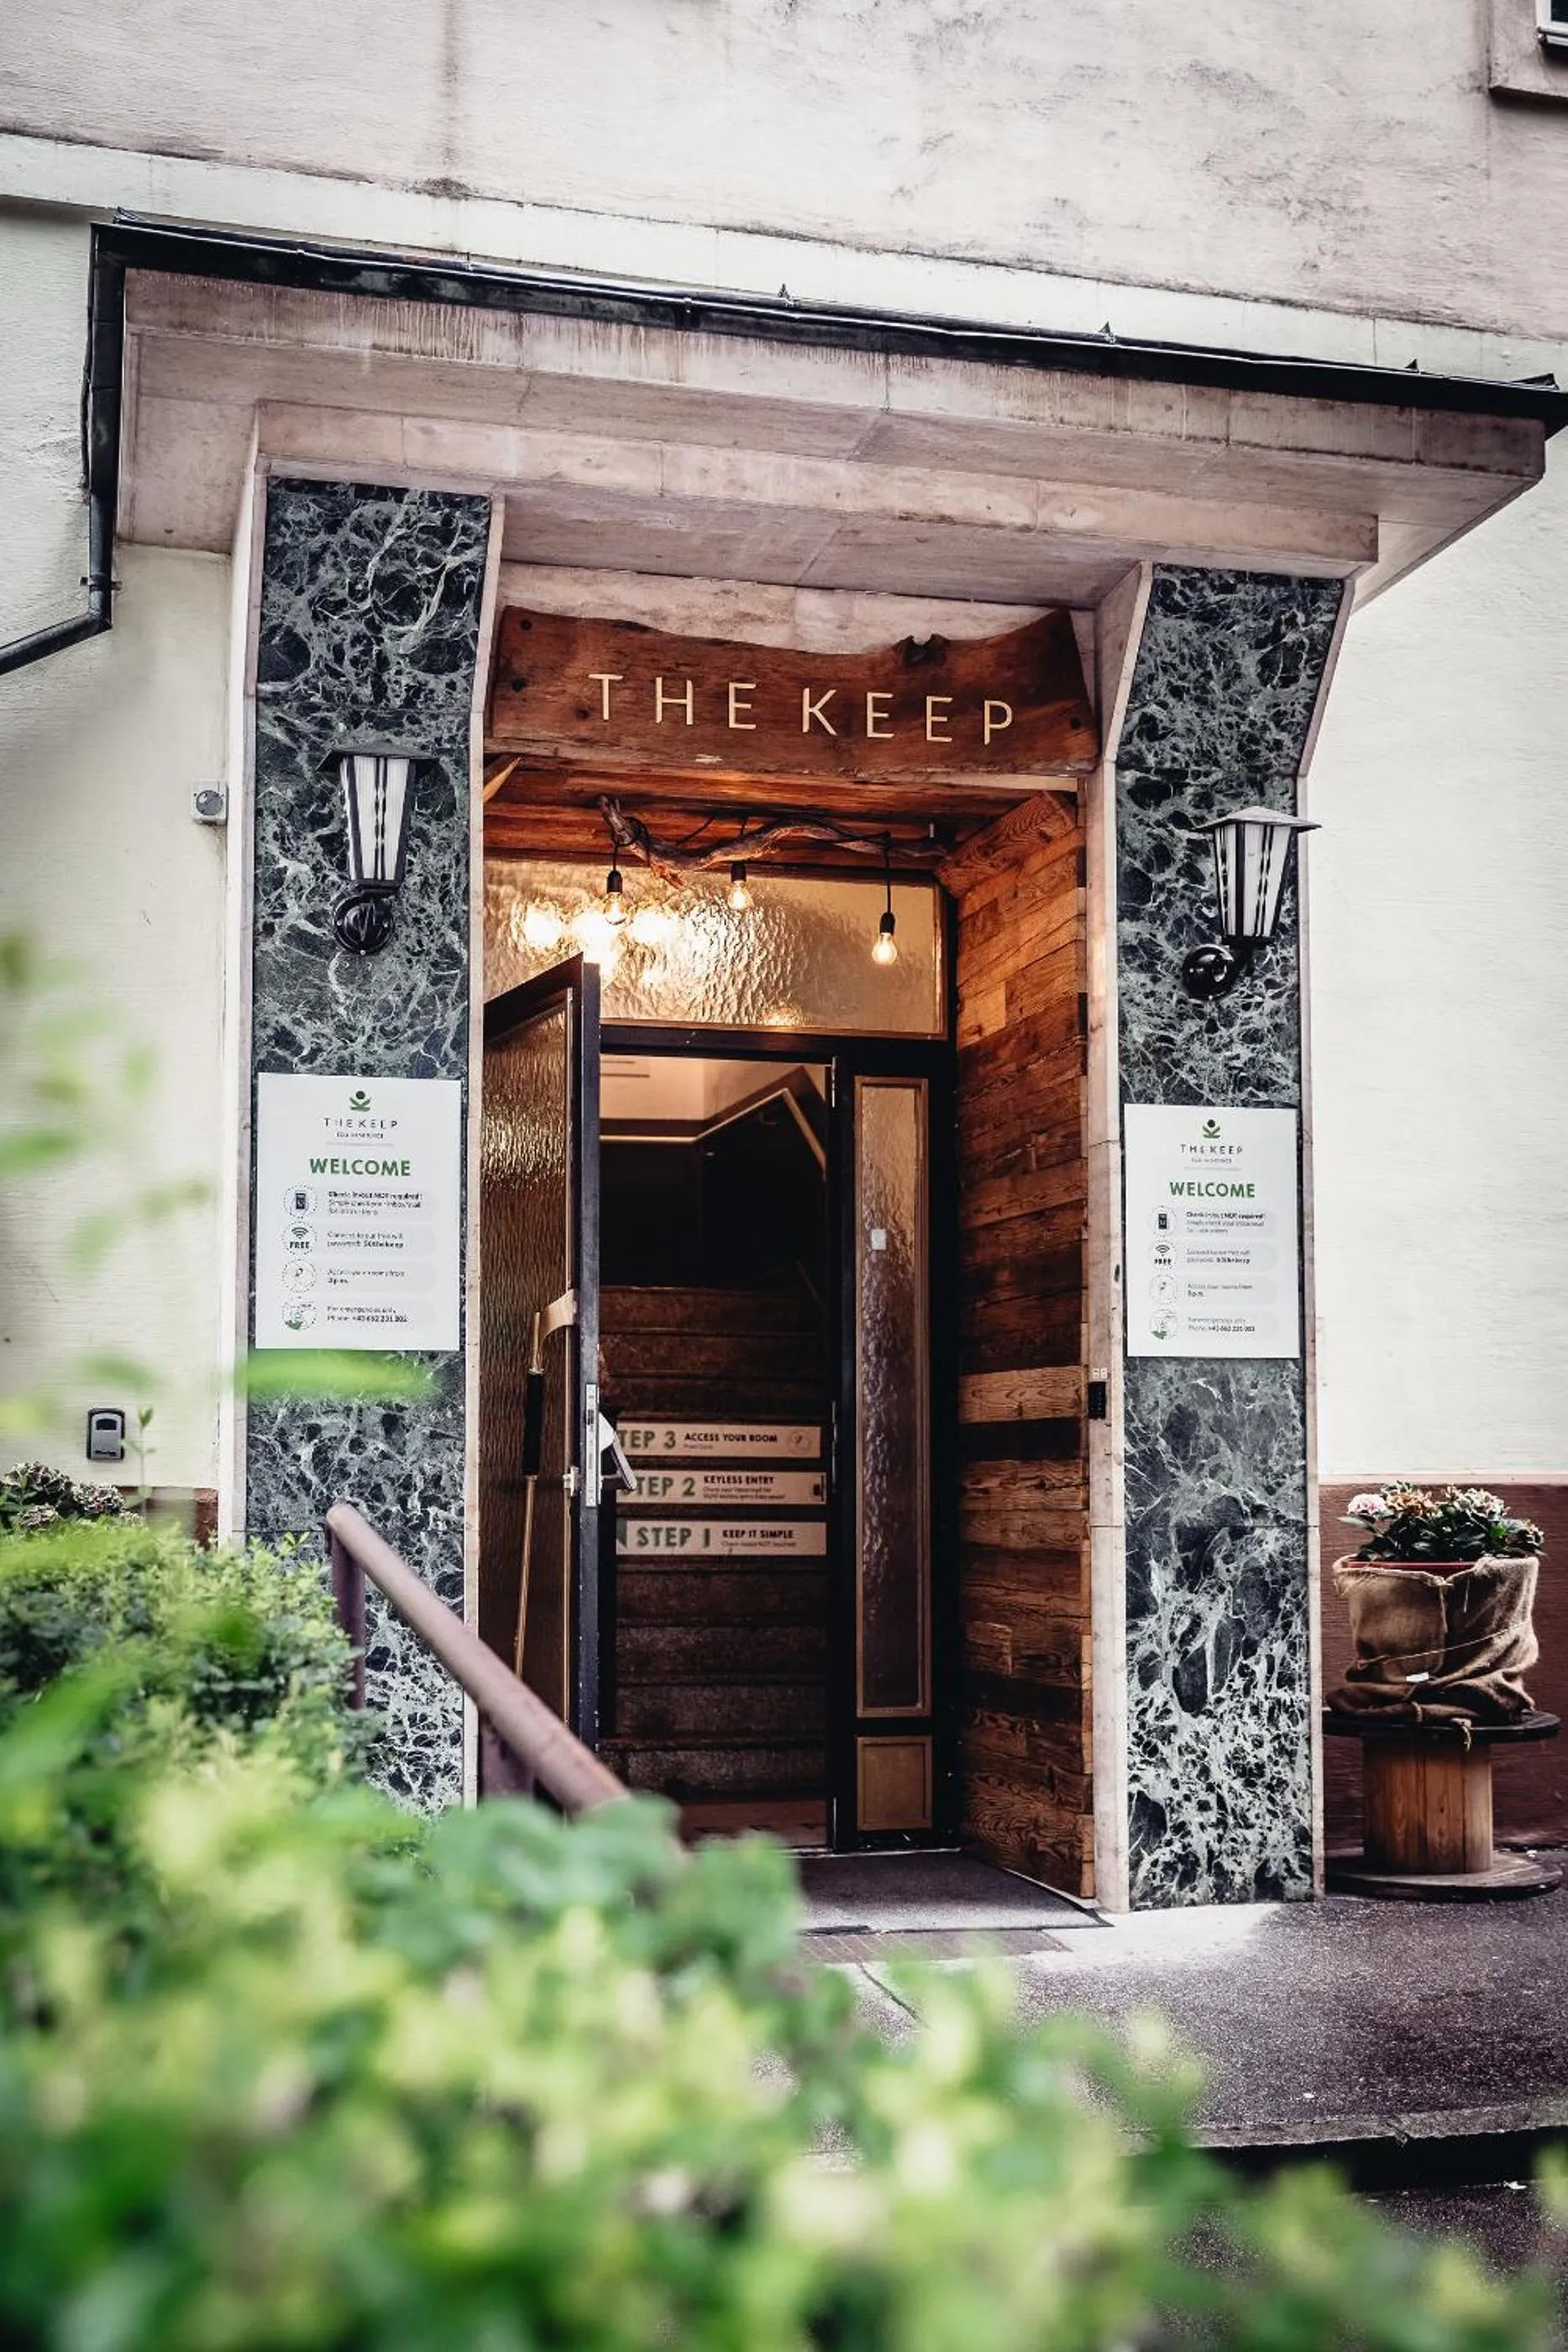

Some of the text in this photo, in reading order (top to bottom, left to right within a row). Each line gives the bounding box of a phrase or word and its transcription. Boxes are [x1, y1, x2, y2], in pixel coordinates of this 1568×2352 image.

[588, 674, 1012, 745] THE KEEP
[309, 1158, 411, 1177] WELCOME
[1169, 1182, 1255, 1198] WELCOME
[616, 1430, 676, 1449] TEP 3
[684, 1432, 778, 1443] ACCESS YOUR ROOM
[623, 1477, 695, 1496] TEP 2
[704, 1476, 774, 1485] KEYLESS ENTRY
[637, 1527, 711, 1548] STEP 1
[722, 1530, 794, 1539] KEEP IT SIMPLE
